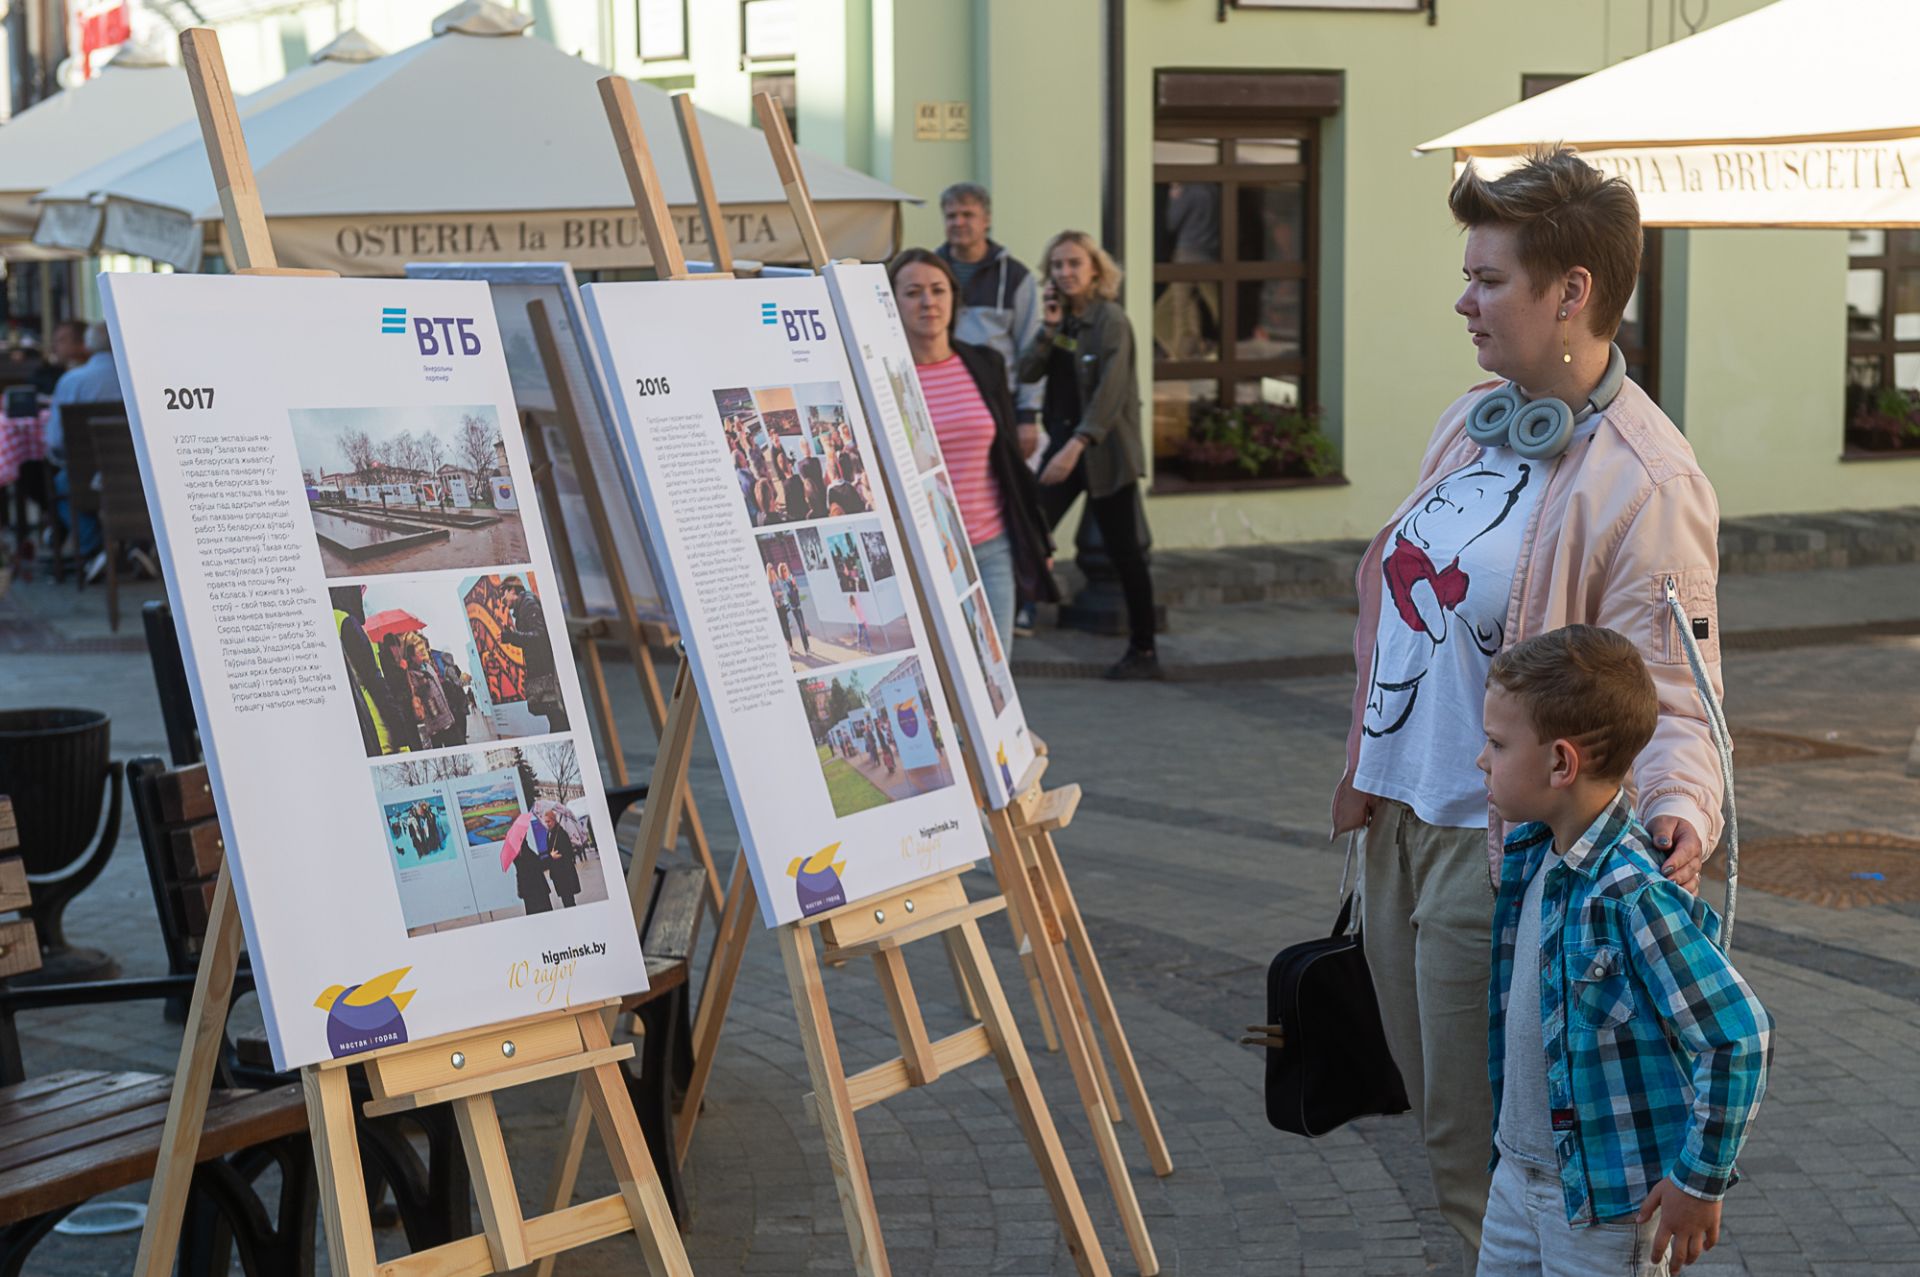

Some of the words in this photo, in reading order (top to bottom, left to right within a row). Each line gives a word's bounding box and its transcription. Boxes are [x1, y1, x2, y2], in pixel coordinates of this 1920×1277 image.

[1674, 154, 1704, 192] la
[1712, 149, 1912, 192] BRUSCETTA
[336, 220, 501, 257] OSTERIA
[518, 221, 546, 251] la
[781, 309, 827, 342] ВТБ
[413, 317, 482, 356] ВТБ
[636, 376, 671, 396] 2016
[164, 388, 215, 410] 2017
[180, 435, 196, 444] 2017
[179, 459, 193, 467] цыя
[194, 457, 240, 466] беларускага
[231, 468, 265, 476] панараму
[215, 479, 258, 488] беларускага
[187, 492, 224, 501] яўленчага
[265, 488, 275, 496] На
[190, 503, 215, 512] стаўцы
[232, 501, 266, 509] адкрытым
[192, 514, 208, 522] былі
[195, 525, 215, 534] работ
[218, 524, 226, 532] 35
[227, 523, 265, 532] беларускіх
[268, 520, 295, 530] аўтараў
[225, 533, 265, 543] пакаленняў
[224, 556, 256, 565] мастакоў
[280, 553, 301, 562] раней
[215, 568, 263, 577] выстаўлялася
[209, 592, 219, 600] ба
[249, 589, 253, 597] У
[212, 603, 233, 612] строў
[241, 601, 258, 609] свой
[242, 621, 296, 631] прадстаўленых
[220, 637, 245, 645] пазіцыі
[279, 631, 304, 641] работы
[263, 644, 301, 653] Уладзіміра
[224, 658, 256, 668] Гаўрыіла
[257, 656, 290, 664] Вашчанкі
[227, 670, 248, 678] іншых
[270, 666, 307, 675] беларускіх
[229, 679, 260, 690] вапісцаў
[298, 673, 332, 683] Выстаўка
[281, 688, 301, 696] цэнтр
[302, 685, 327, 693] Мінска
[235, 704, 264, 712] працягу
[266, 701, 295, 709] чатырох
[919, 819, 959, 839] higminsk.by
[541, 941, 606, 965] higminsk.by
[507, 960, 529, 990] 10
[339, 1039, 368, 1050] мастак
[374, 1032, 398, 1044] горад
